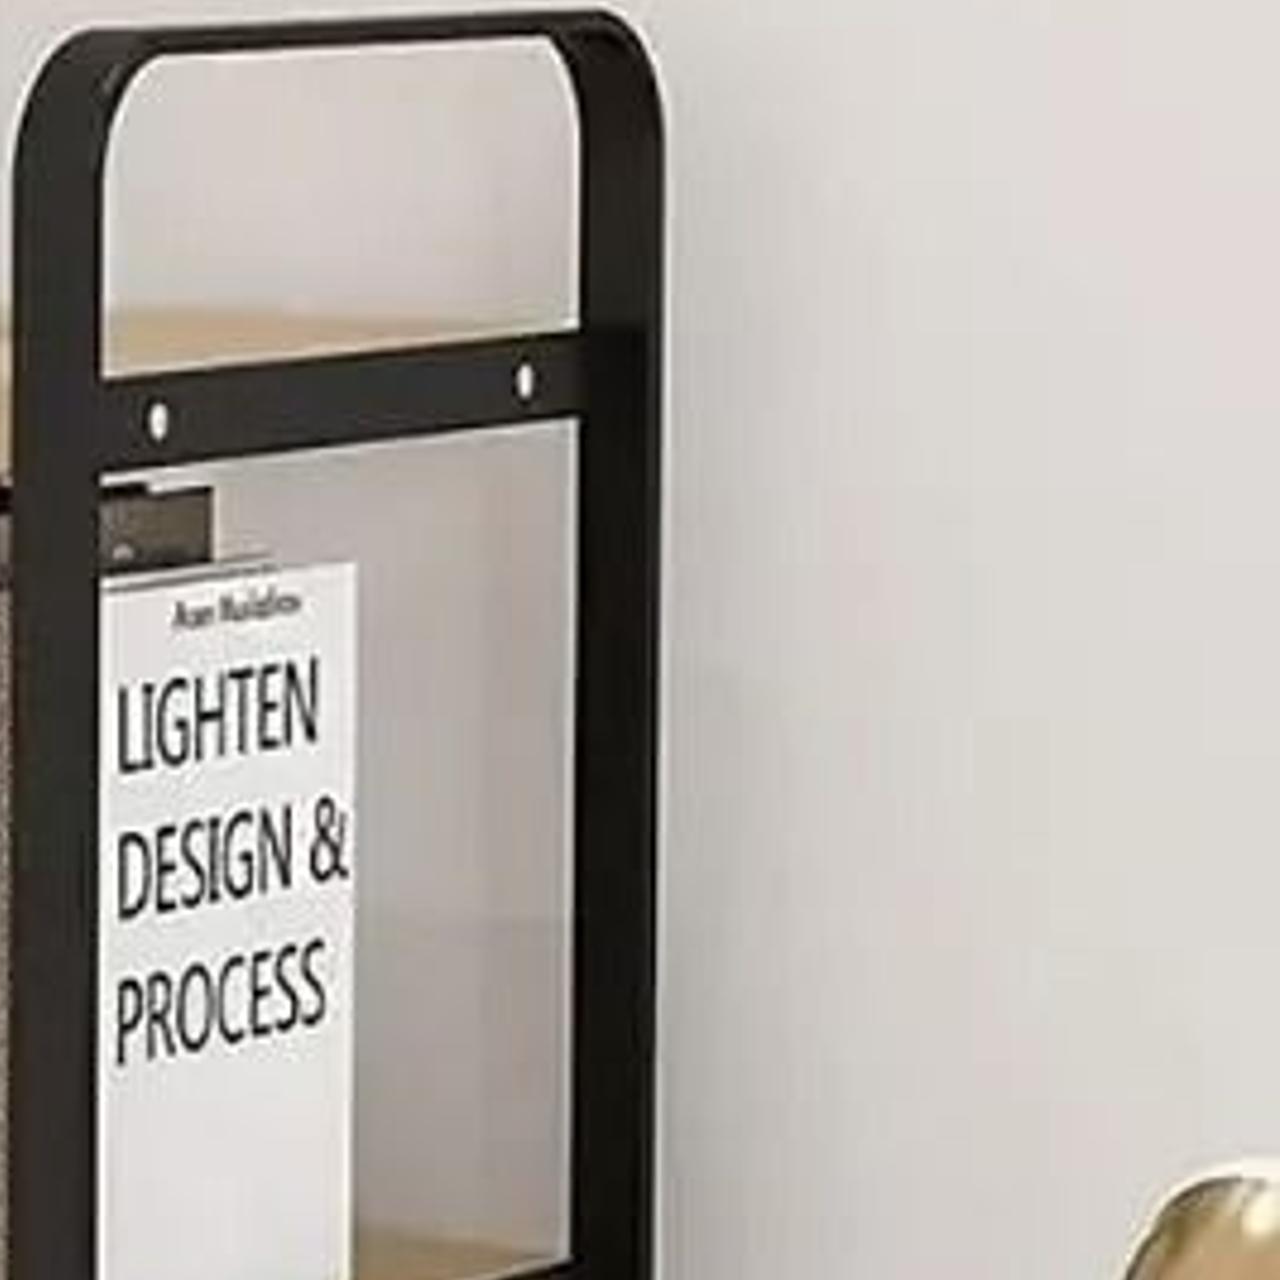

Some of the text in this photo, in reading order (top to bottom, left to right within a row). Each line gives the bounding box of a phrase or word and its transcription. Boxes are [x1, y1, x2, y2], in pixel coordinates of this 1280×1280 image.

[117, 654, 320, 776] LIGHTEN
[117, 794, 350, 921] DESIGN &
[116, 937, 326, 1067] PROCESS
